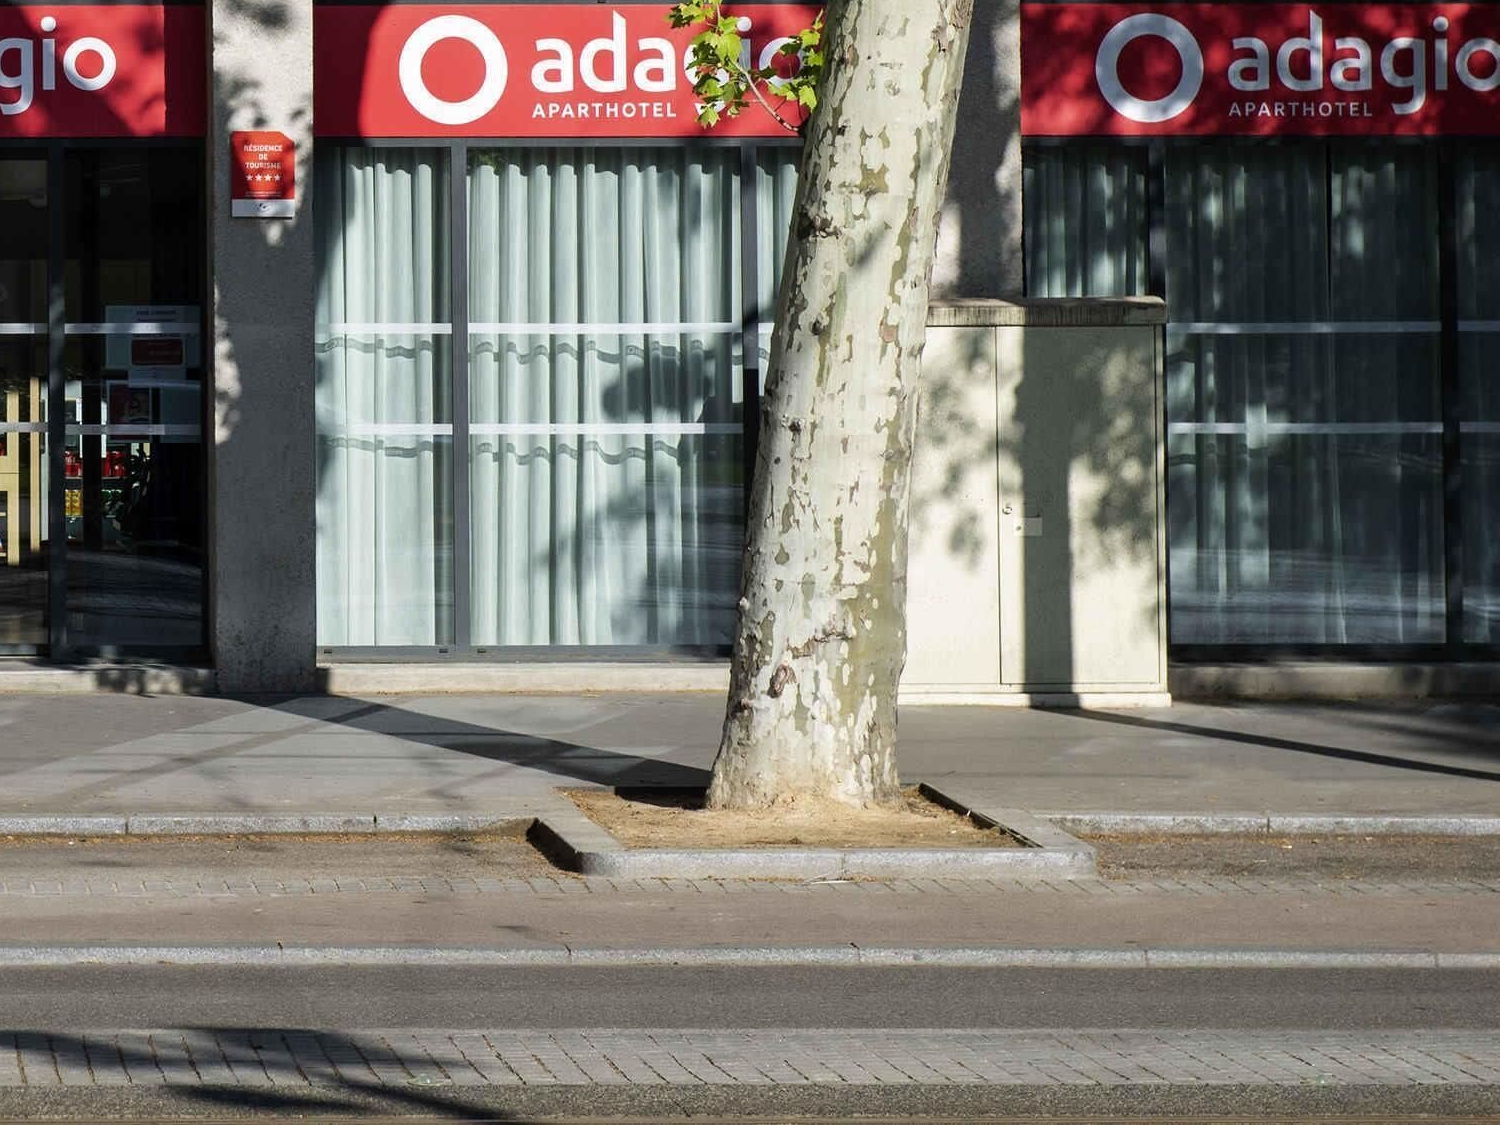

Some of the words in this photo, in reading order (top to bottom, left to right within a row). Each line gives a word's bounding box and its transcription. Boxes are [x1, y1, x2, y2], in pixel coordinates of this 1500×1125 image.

[1227, 9, 1500, 115] adagio
[531, 102, 677, 118] APARTHOTEL
[1228, 101, 1373, 117] APARTHOTEL
